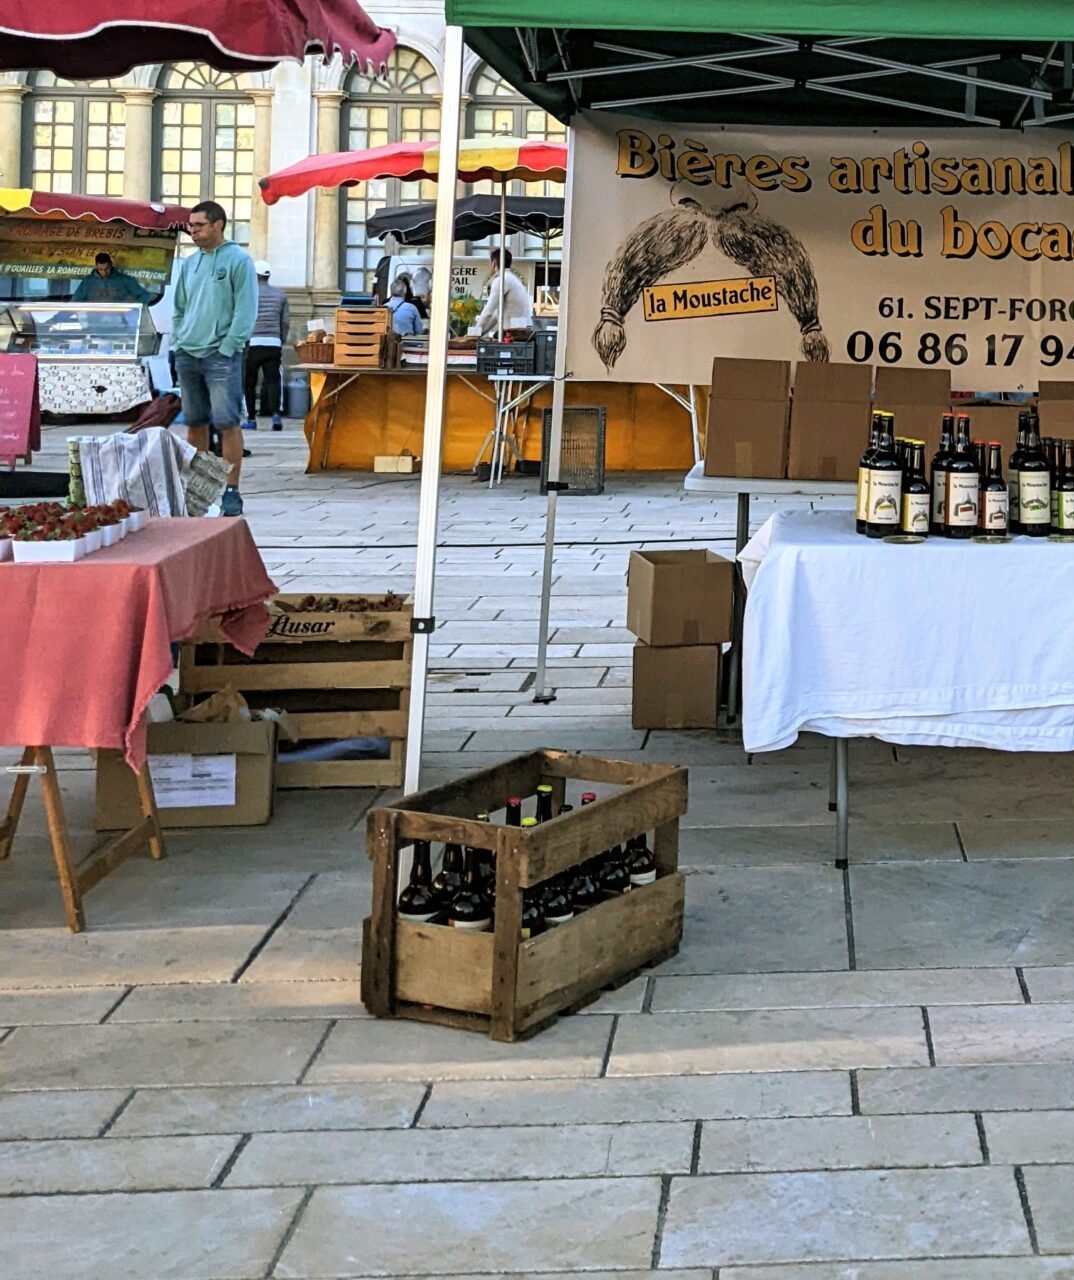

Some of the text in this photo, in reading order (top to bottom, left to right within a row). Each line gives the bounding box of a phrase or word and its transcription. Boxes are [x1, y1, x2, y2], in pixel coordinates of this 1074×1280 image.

[615, 128, 812, 193] Bières
[85, 226, 126, 238] BREBIS
[851, 204, 923, 257] du
[46, 265, 55, 274] LA
[451, 265, 478, 276] GÈRE
[649, 281, 772, 314] la Moustache
[878, 297, 913, 319] 61.
[847, 331, 903, 363] 06
[917, 332, 968, 366] 86
[985, 333, 1024, 367] 17
